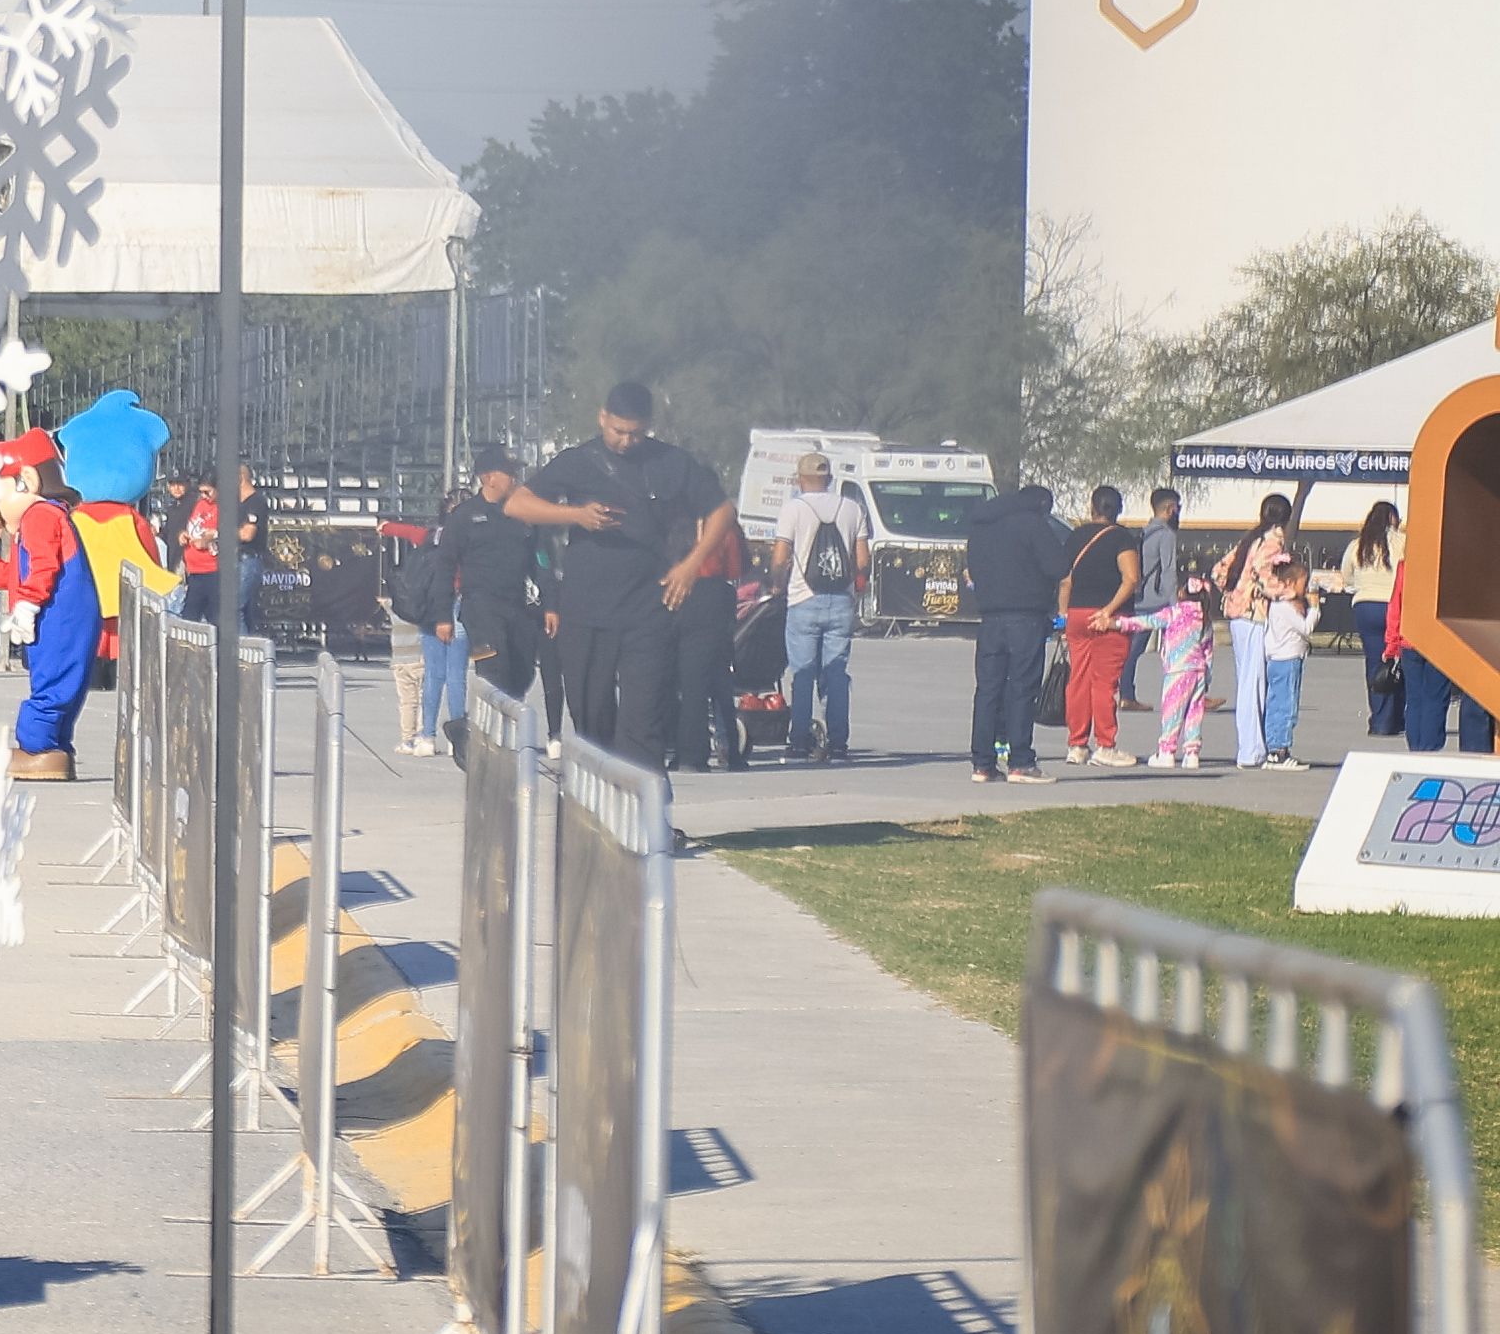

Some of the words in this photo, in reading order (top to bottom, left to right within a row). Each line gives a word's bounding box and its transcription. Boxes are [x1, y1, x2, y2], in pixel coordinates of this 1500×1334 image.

[1176, 454, 1247, 469] CHURROS
[1264, 455, 1336, 471] CHURROS
[1357, 455, 1411, 472] CHURR
[262, 572, 311, 587] NAVIDAD
